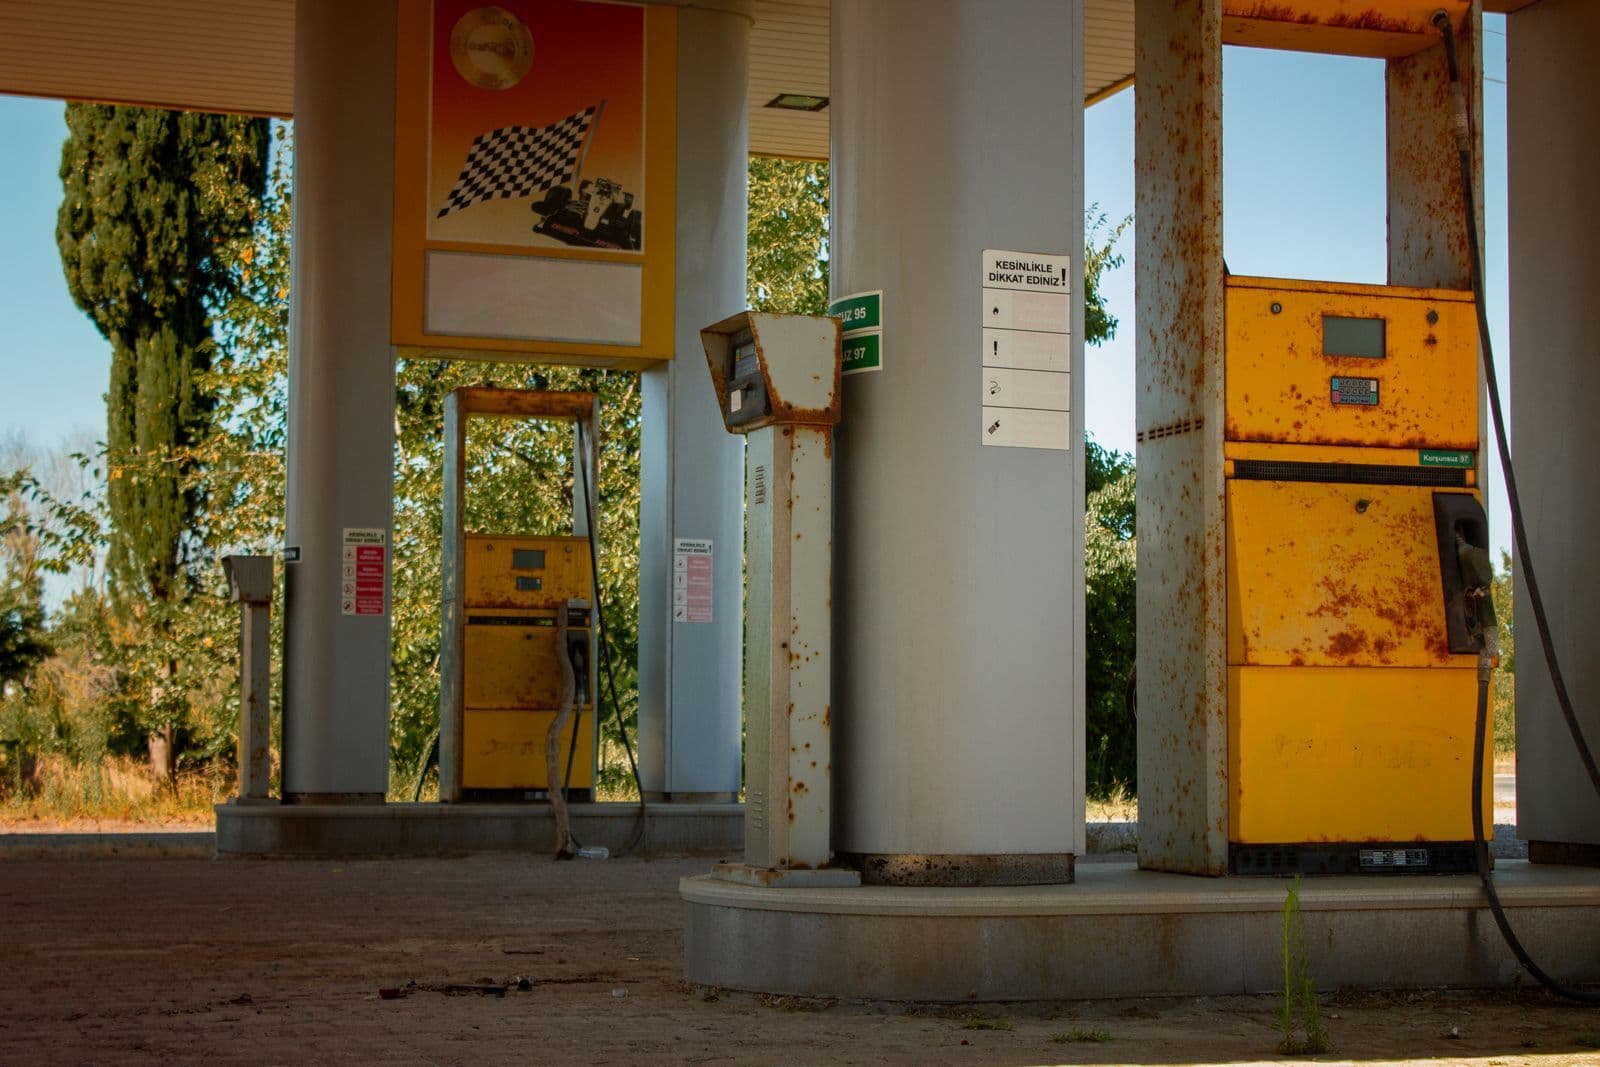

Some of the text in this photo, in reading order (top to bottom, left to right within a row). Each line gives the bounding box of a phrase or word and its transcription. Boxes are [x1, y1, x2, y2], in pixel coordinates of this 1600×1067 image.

[995, 260, 1053, 273] KESİNLİKLE
[989, 271, 1024, 284] DİKKAT
[854, 307, 866, 320] 95
[854, 347, 866, 360] 97
